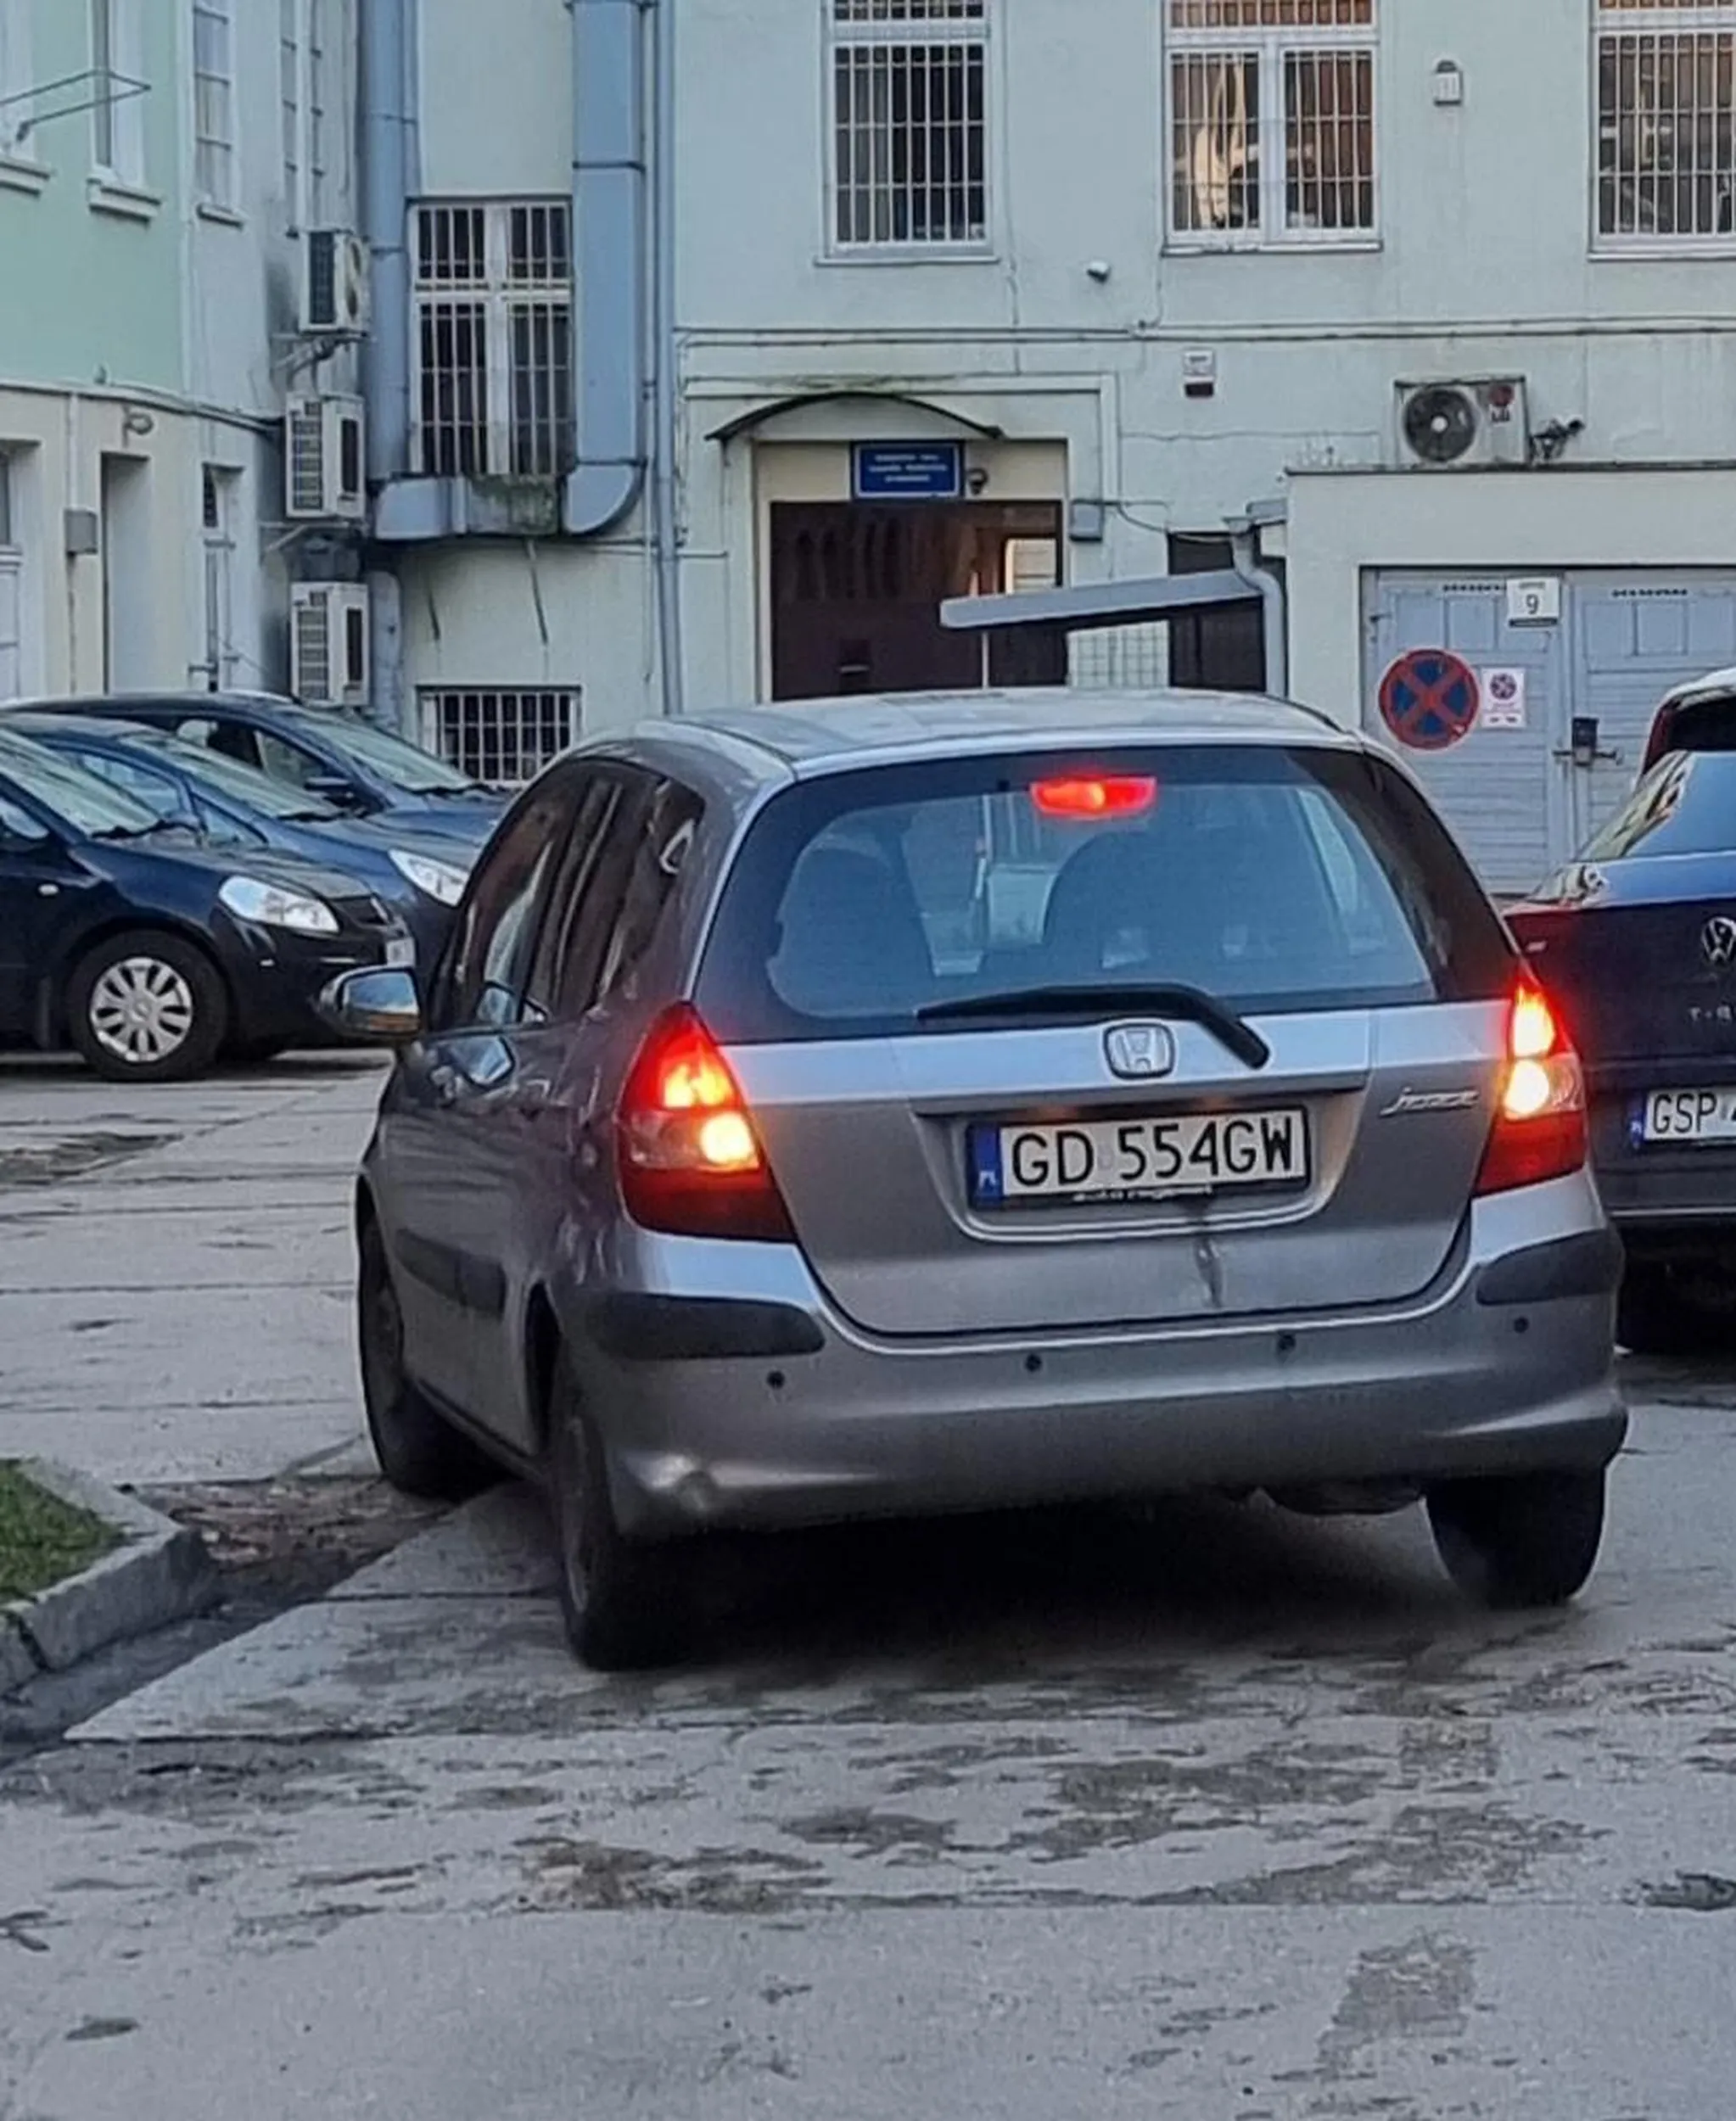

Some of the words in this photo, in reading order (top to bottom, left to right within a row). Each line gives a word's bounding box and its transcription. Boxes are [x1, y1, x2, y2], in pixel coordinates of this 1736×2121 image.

[1526, 594, 1538, 615] 9
[1653, 1093, 1717, 1133] GSP
[1011, 1129, 1094, 1187] GD
[1117, 1115, 1292, 1180] 554GW
